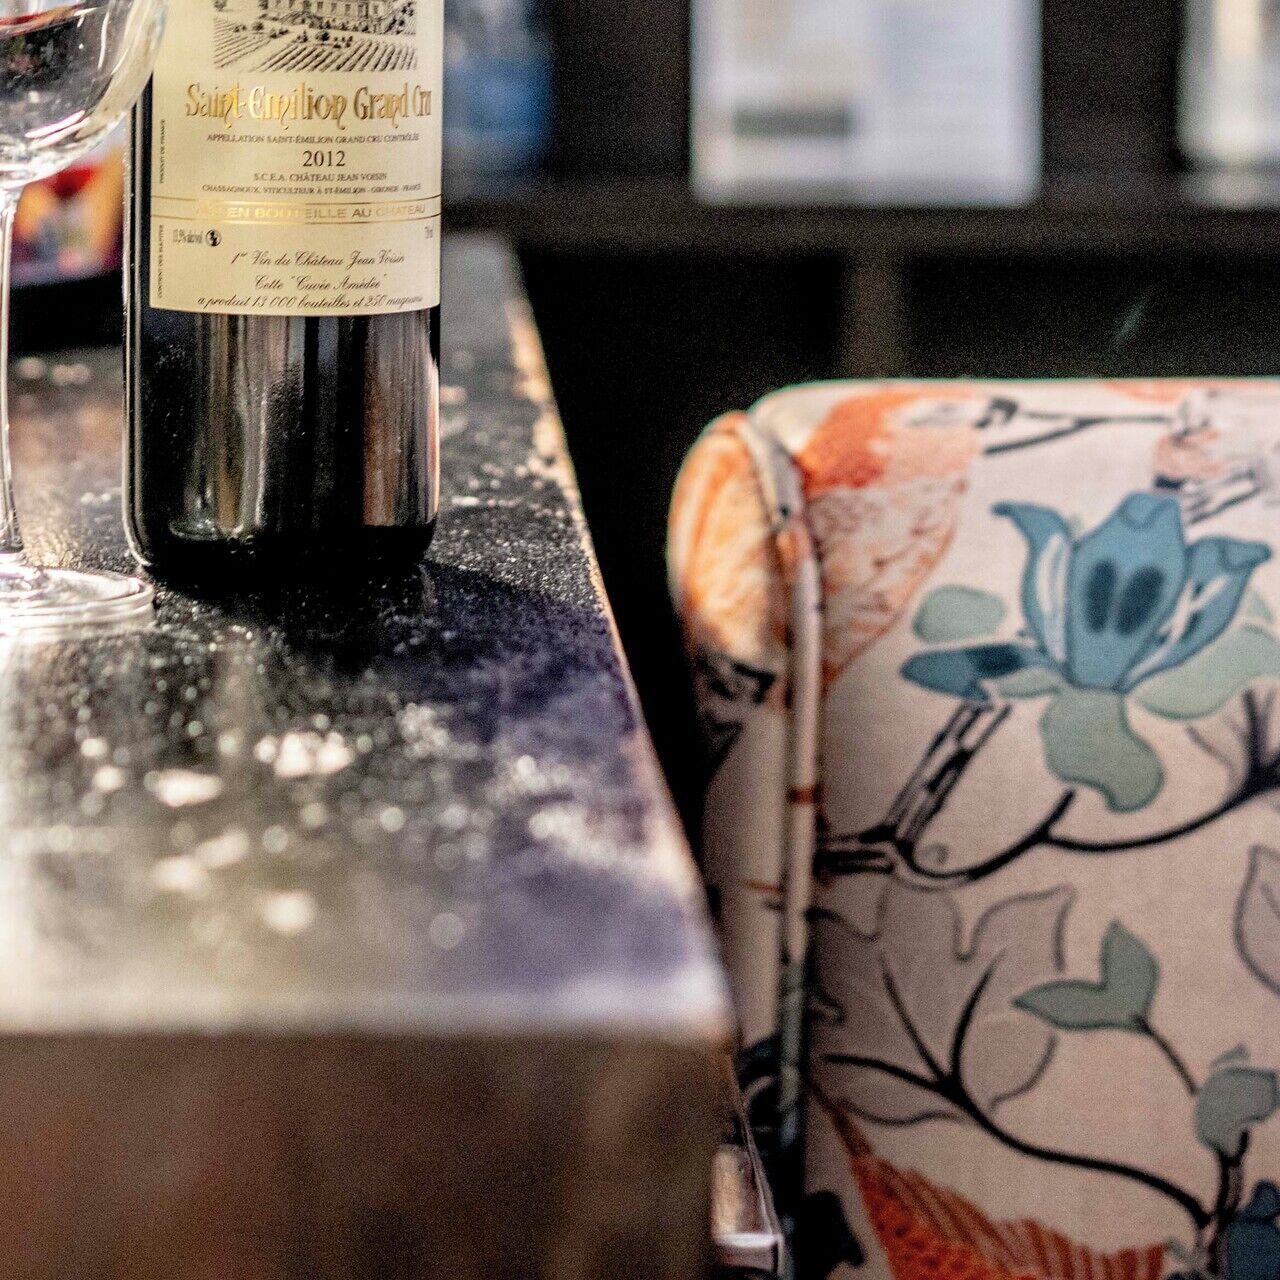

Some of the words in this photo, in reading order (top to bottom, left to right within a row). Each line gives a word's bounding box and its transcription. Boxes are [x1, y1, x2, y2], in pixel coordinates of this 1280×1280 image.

[354, 82, 409, 129] Grand
[412, 84, 432, 117] Cru
[206, 133, 264, 143] APPELLATION
[335, 135, 366, 144] GRAND
[367, 135, 382, 143] CRU
[302, 150, 346, 167] 2012
[337, 172, 360, 182] JEAN
[361, 172, 387, 181] VOISIN
[227, 206, 250, 218] EN
[351, 206, 371, 218] AU
[251, 250, 271, 265] Vin
[275, 252, 291, 266] du
[295, 251, 343, 266] Château
[346, 250, 375, 270] Jean
[377, 249, 405, 265] Voisin
[254, 274, 284, 290] Cette
[204, 294, 250, 309] produit
[269, 296, 297, 308] 000
[297, 294, 350, 308] bouteilles
[352, 295, 362, 308] et
